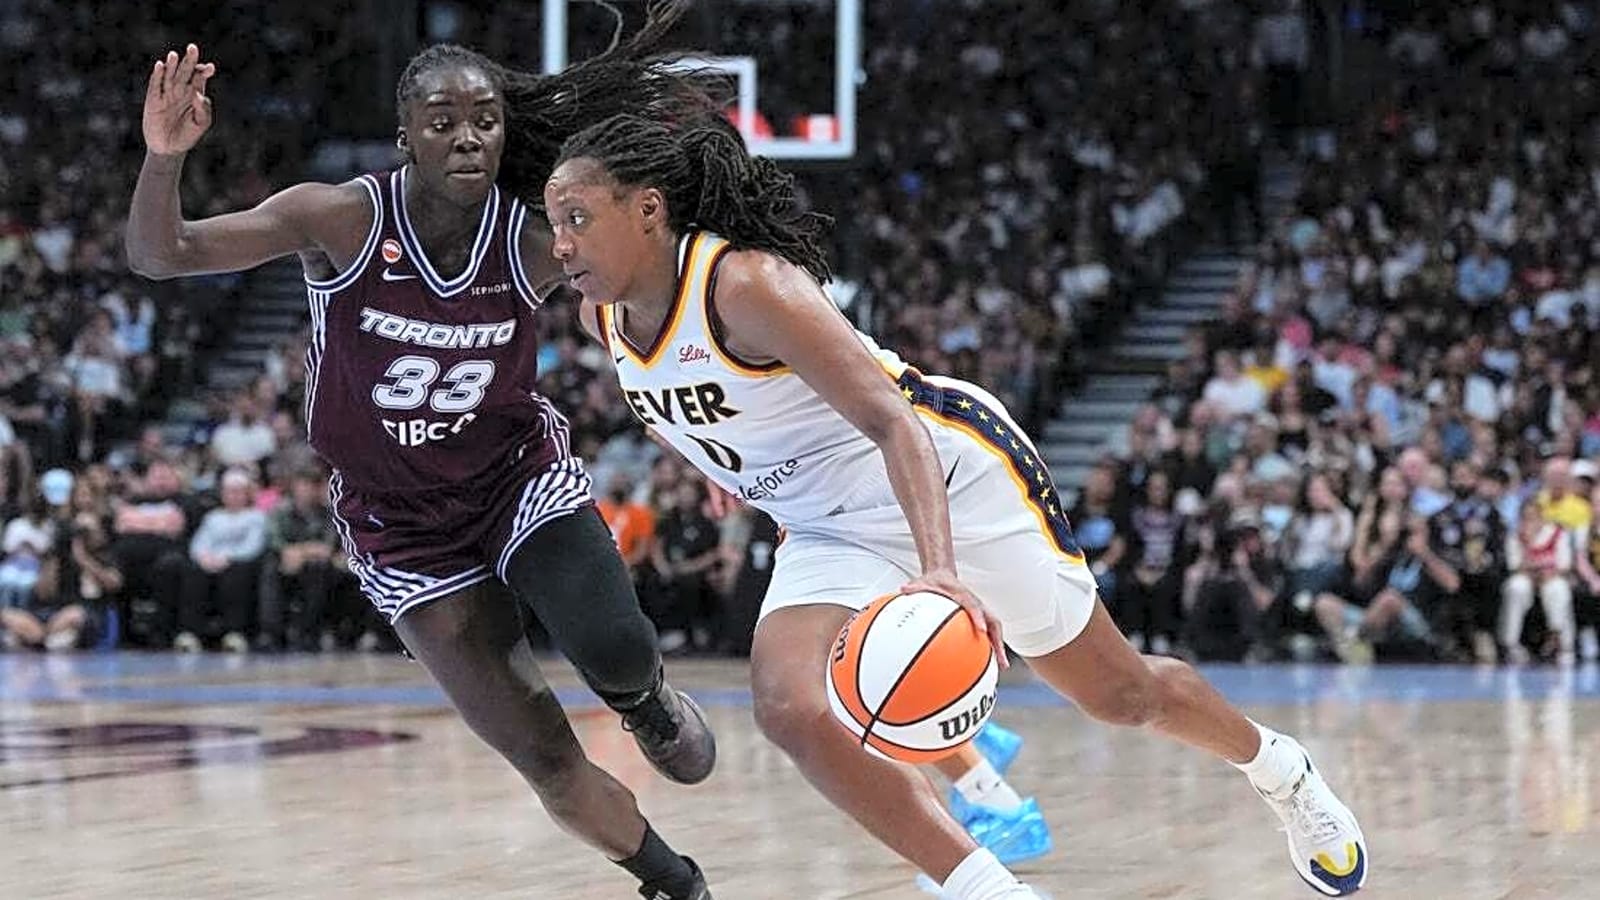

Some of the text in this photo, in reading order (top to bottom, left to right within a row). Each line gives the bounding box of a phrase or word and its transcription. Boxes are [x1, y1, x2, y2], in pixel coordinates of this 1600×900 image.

[360, 306, 517, 349] TORONTO
[678, 344, 710, 362] Lilly
[371, 355, 496, 413] 33
[625, 382, 743, 425] EVER
[737, 459, 802, 501] lesforce
